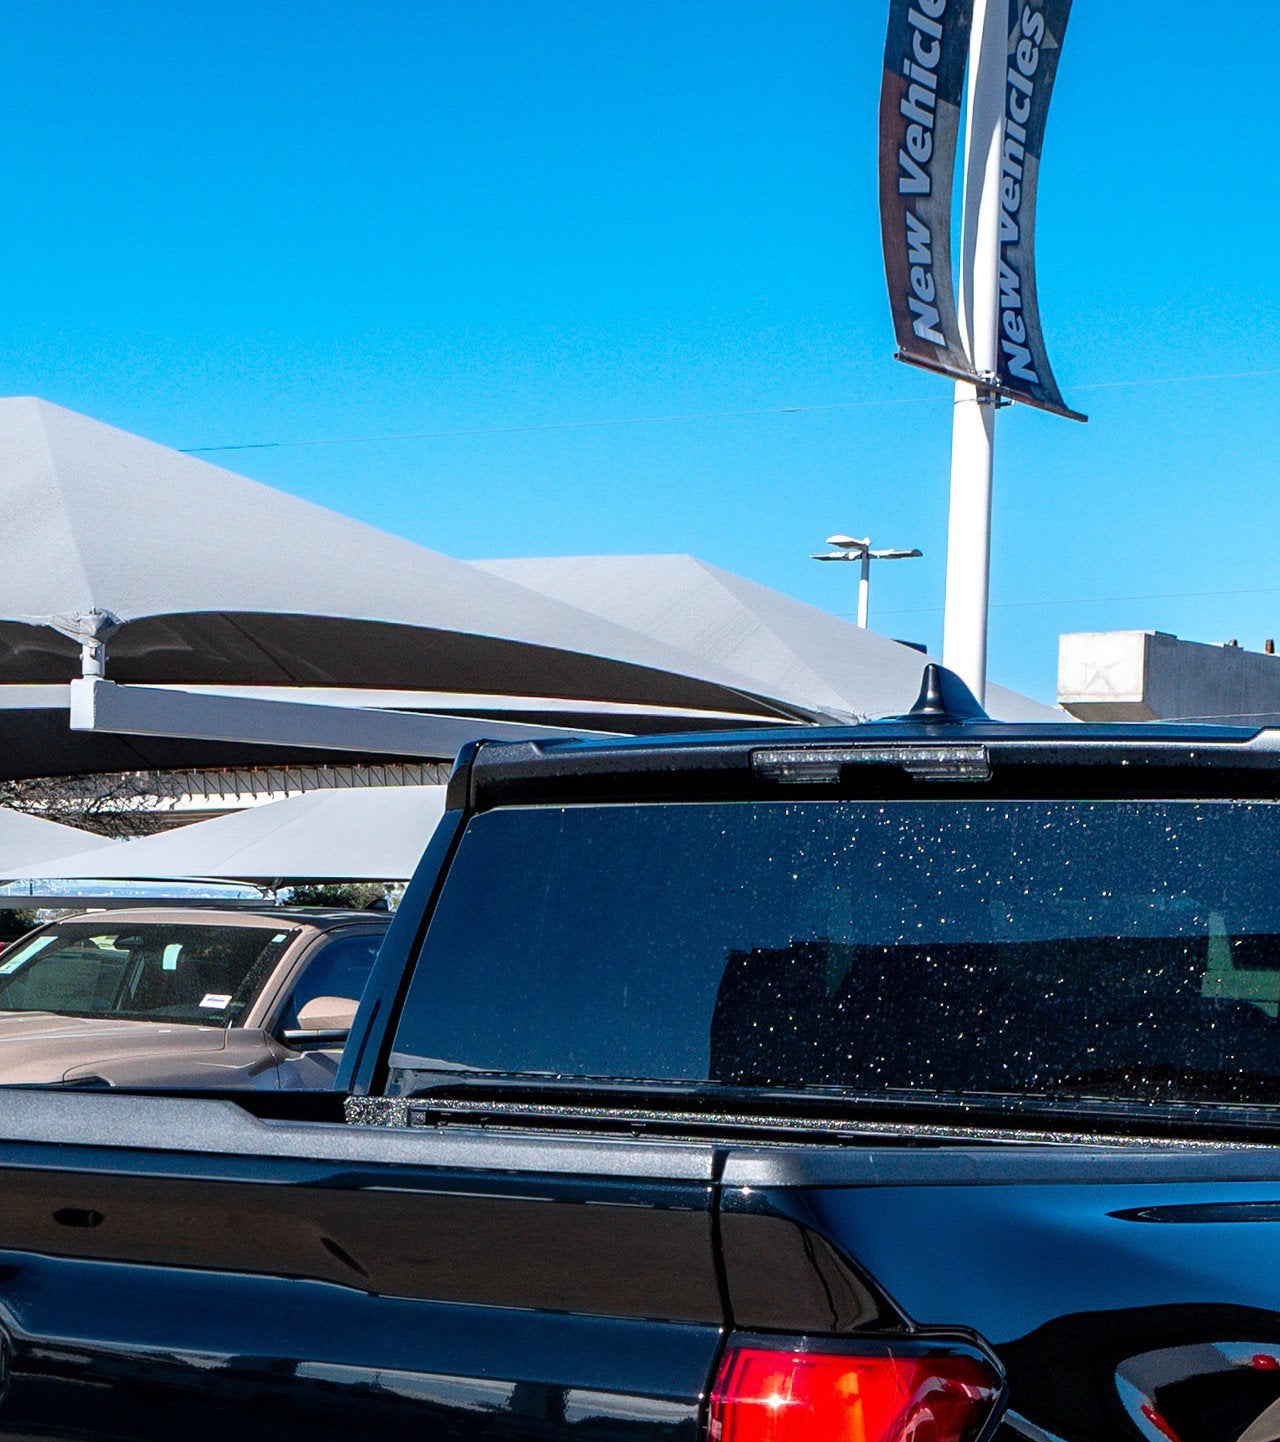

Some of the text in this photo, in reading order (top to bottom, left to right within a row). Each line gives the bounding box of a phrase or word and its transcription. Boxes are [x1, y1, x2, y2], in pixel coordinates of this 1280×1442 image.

[905, 211, 947, 348] New
[1000, 5, 1045, 384] New Vehicles
